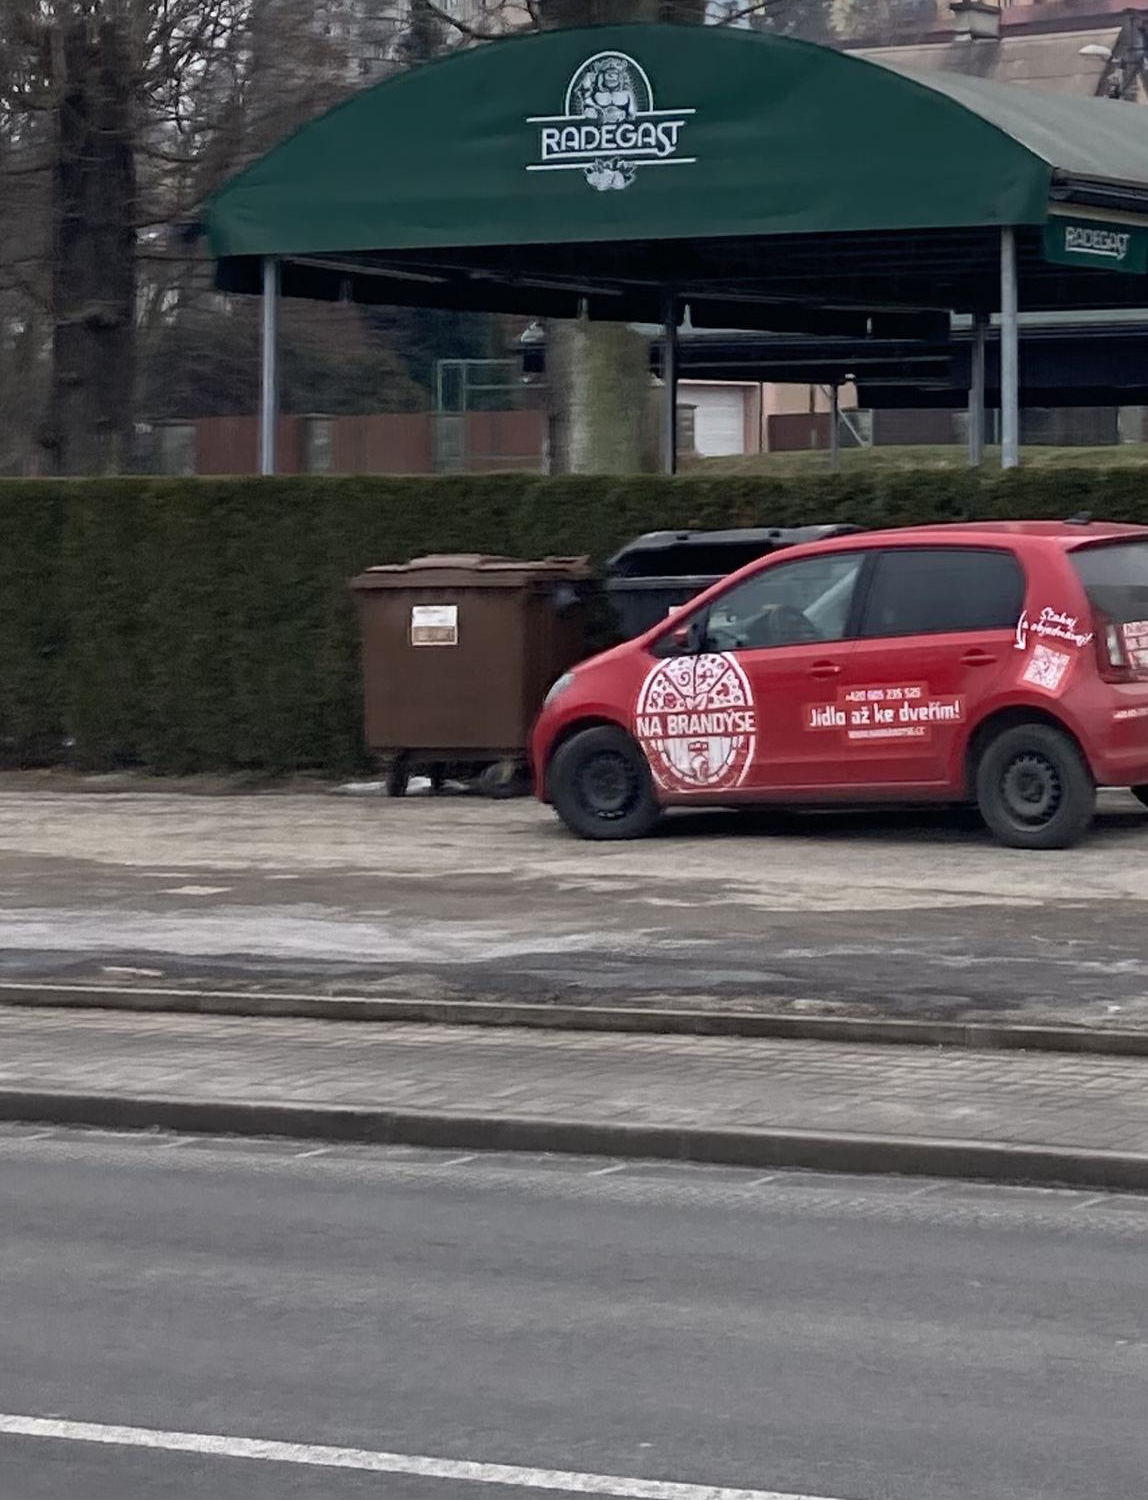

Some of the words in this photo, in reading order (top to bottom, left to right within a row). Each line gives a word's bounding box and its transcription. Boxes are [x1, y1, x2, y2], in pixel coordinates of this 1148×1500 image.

[542, 121, 685, 159] RADEGAST
[636, 717, 662, 737] NA
[667, 708, 756, 736] BRANDÝSE
[809, 705, 846, 727] Jídlo
[851, 706, 871, 725] až
[874, 703, 895, 723] ke
[899, 700, 961, 722] dveřím!
